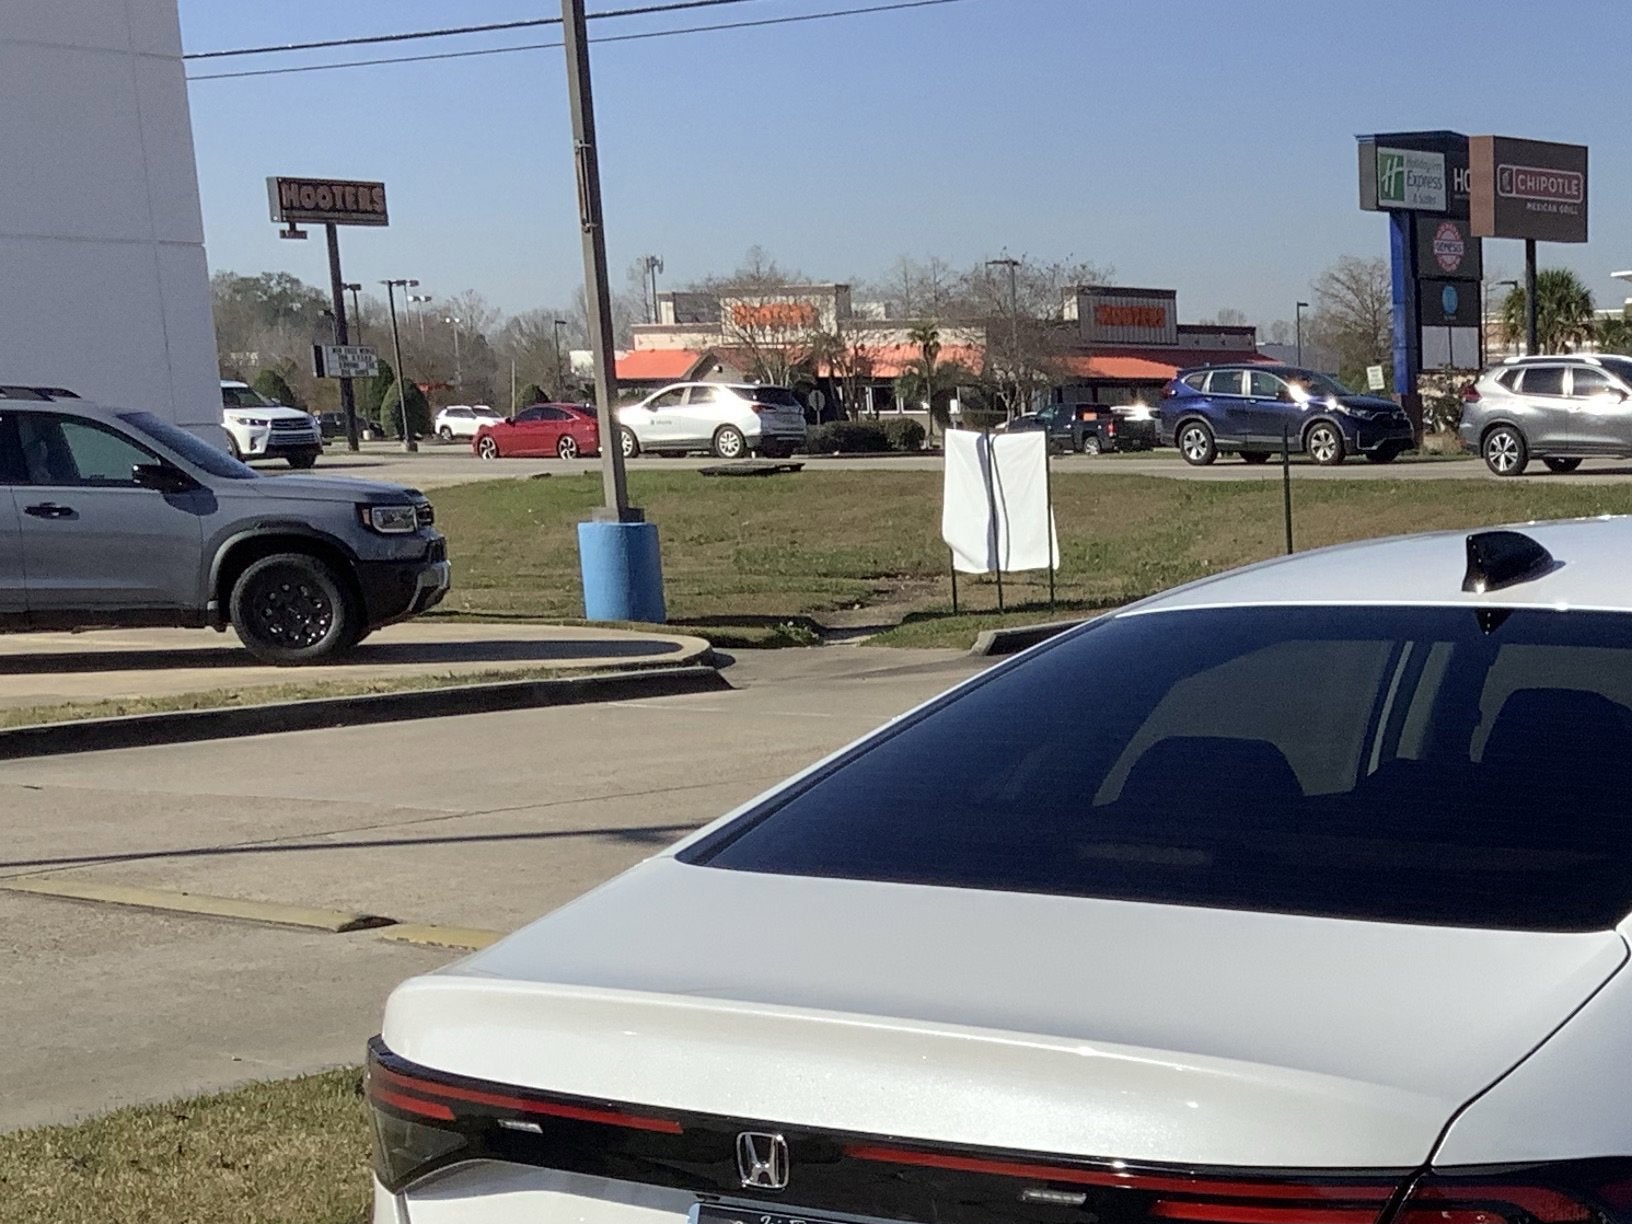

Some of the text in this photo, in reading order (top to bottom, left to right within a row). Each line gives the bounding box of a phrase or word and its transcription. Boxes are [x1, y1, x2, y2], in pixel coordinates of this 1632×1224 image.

[1406, 169, 1443, 191] Express
[1517, 173, 1579, 196] CHIPOTLE
[280, 180, 385, 213] HOOTERS
[1526, 202, 1578, 215] MEXICAN GRILL
